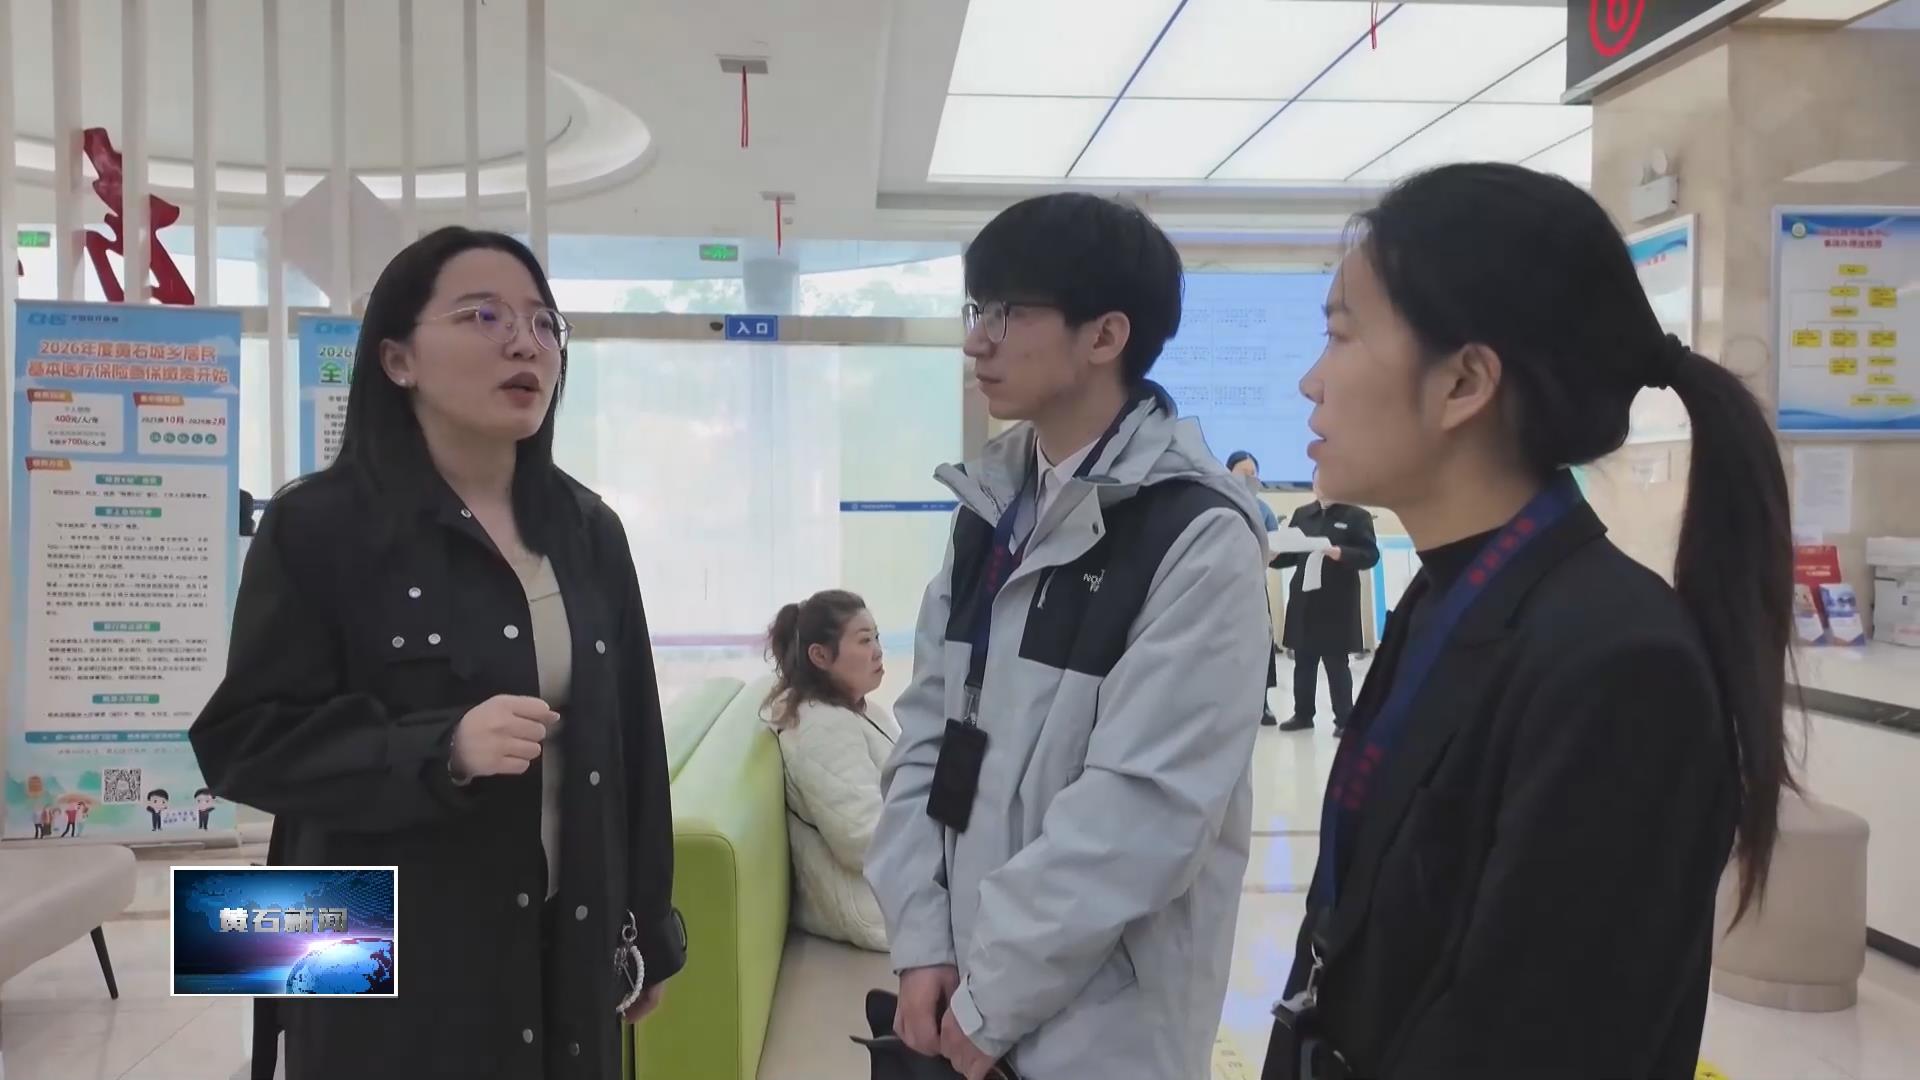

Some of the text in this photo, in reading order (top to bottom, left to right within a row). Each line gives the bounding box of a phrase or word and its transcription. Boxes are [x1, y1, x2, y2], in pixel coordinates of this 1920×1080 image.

[737, 321, 768, 335] 入口
[40, 340, 217, 362] 2026年度黄石城乡居民
